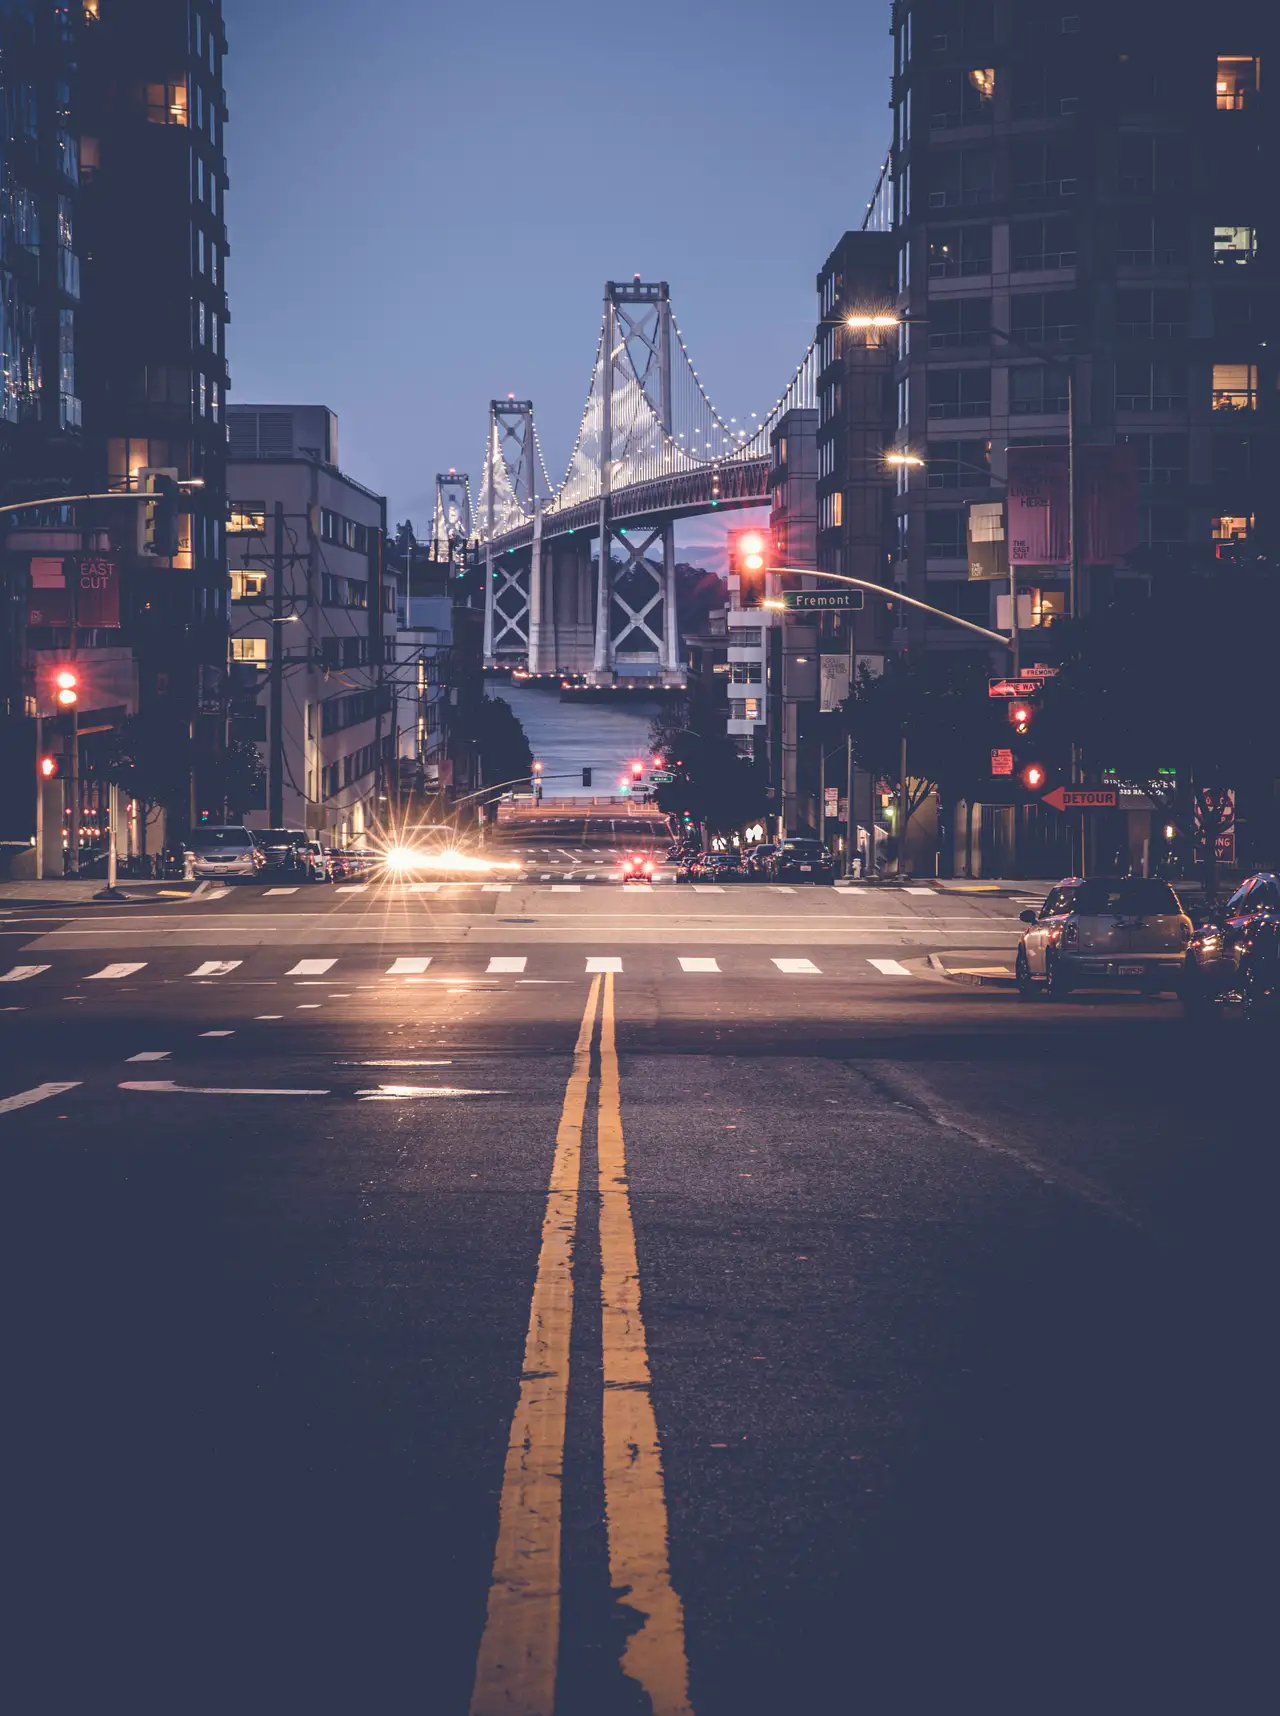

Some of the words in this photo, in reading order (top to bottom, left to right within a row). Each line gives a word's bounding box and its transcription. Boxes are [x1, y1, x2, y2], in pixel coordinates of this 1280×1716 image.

[80, 563, 115, 576] EAST
[80, 576, 109, 589] CUT
[796, 596, 850, 606] Fremont
[1062, 794, 1113, 804] DETOUR
